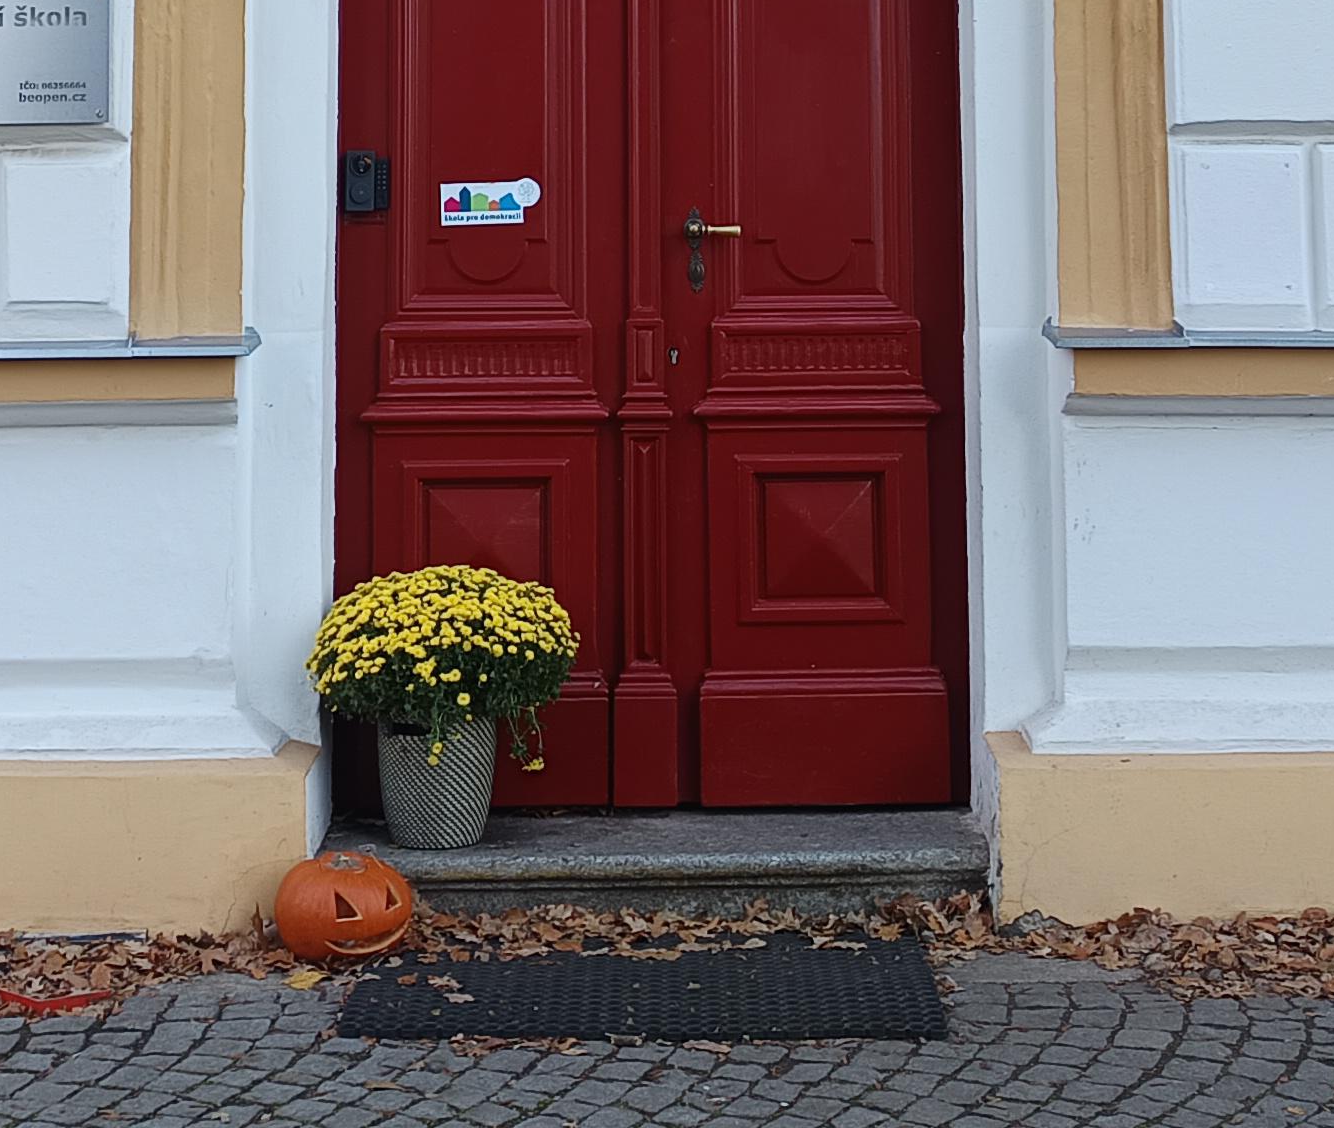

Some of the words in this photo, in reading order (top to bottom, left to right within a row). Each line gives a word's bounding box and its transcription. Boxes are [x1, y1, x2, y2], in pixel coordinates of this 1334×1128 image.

[13, 5, 87, 27] škola
[19, 80, 39, 90] IČO:
[19, 92, 87, 104] beopen.cz
